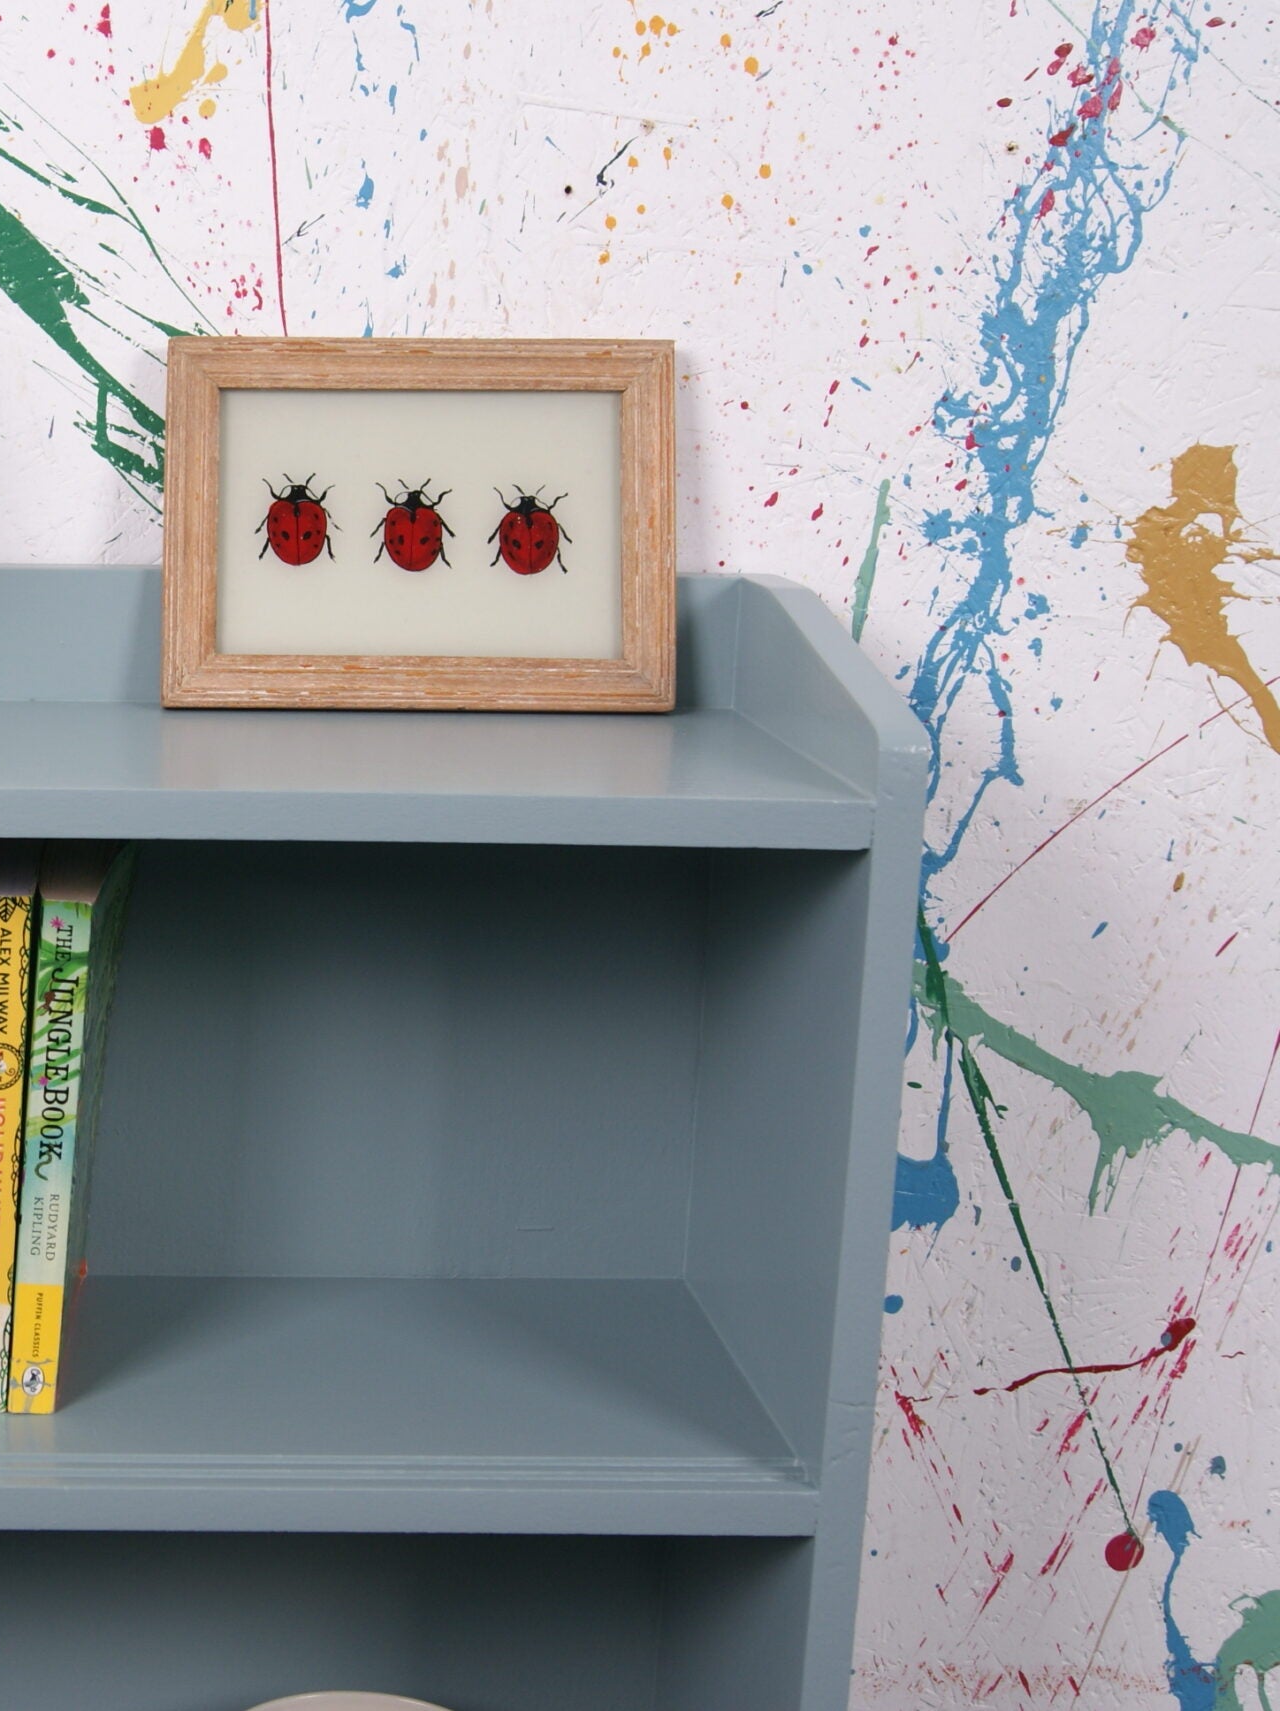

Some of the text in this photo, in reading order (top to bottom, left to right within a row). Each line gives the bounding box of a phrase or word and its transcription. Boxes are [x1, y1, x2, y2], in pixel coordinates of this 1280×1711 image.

[38, 925, 80, 1161] THE JUNGLE BOOK
[30, 1196, 44, 1256] KIPLING
[45, 1193, 60, 1262] RUDYARD
[32, 1292, 43, 1358] PUFFIN CLASSICS
